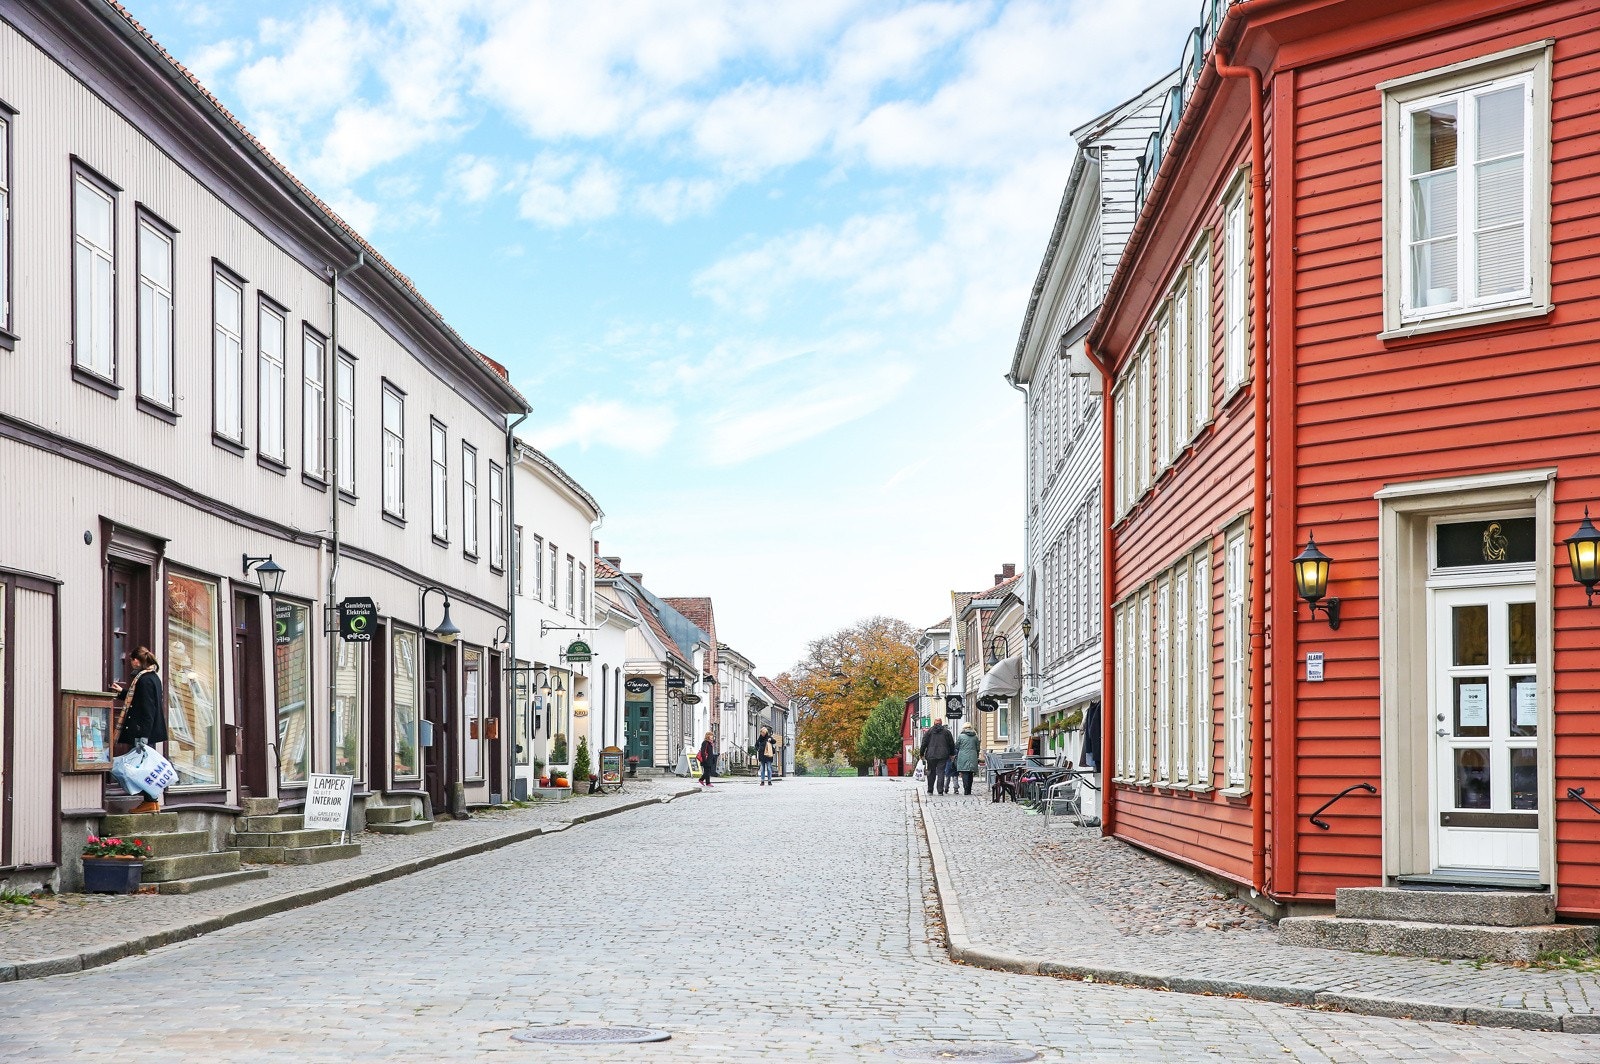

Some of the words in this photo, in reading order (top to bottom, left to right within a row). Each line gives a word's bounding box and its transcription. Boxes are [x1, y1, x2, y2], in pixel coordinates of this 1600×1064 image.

[347, 632, 370, 640] elfag
[144, 762, 168, 784] REMA
[156, 770, 173, 788] 1000
[314, 778, 345, 790] LAMPER
